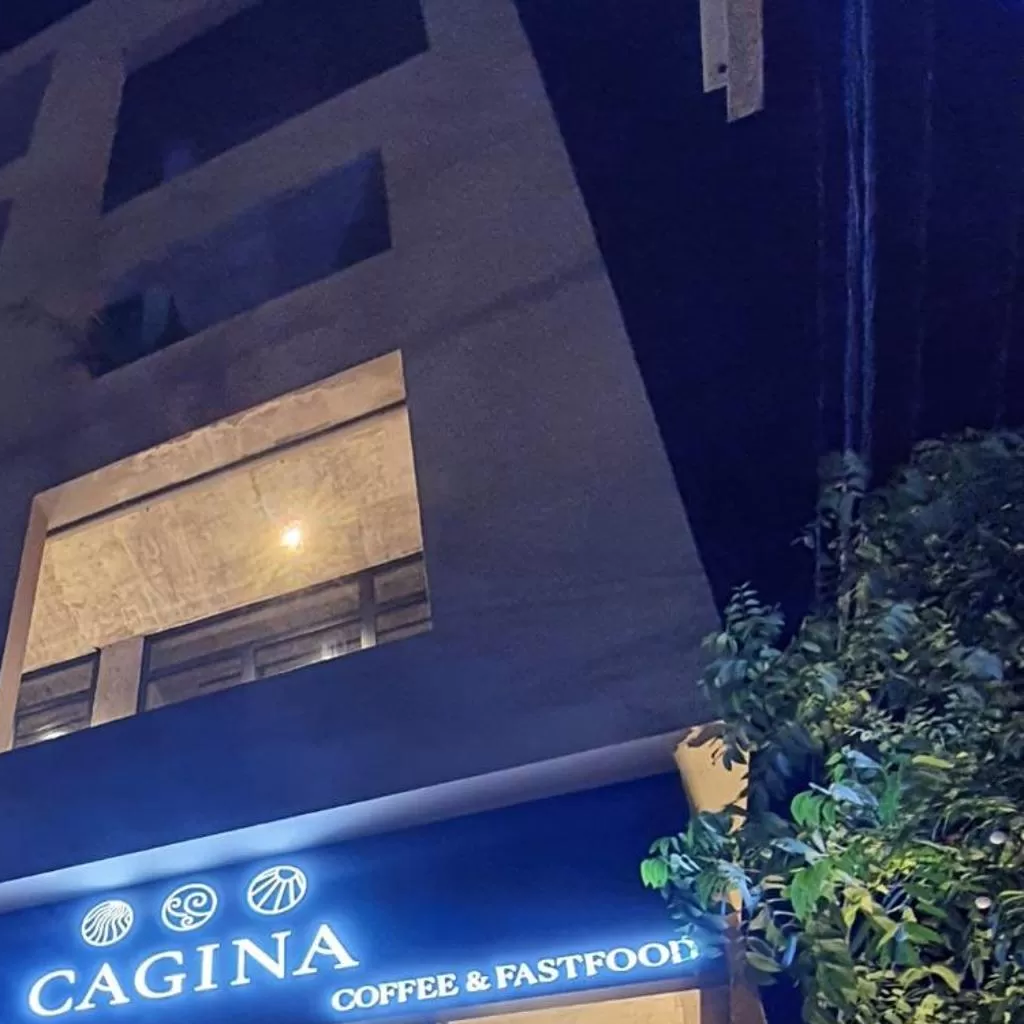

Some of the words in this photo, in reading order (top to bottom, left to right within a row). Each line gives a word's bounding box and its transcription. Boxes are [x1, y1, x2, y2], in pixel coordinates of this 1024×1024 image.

[28, 924, 360, 1016] CAGINA
[331, 973, 459, 1011] COFFEE
[465, 970, 491, 992] &
[495, 938, 699, 989] FASTFOOD
